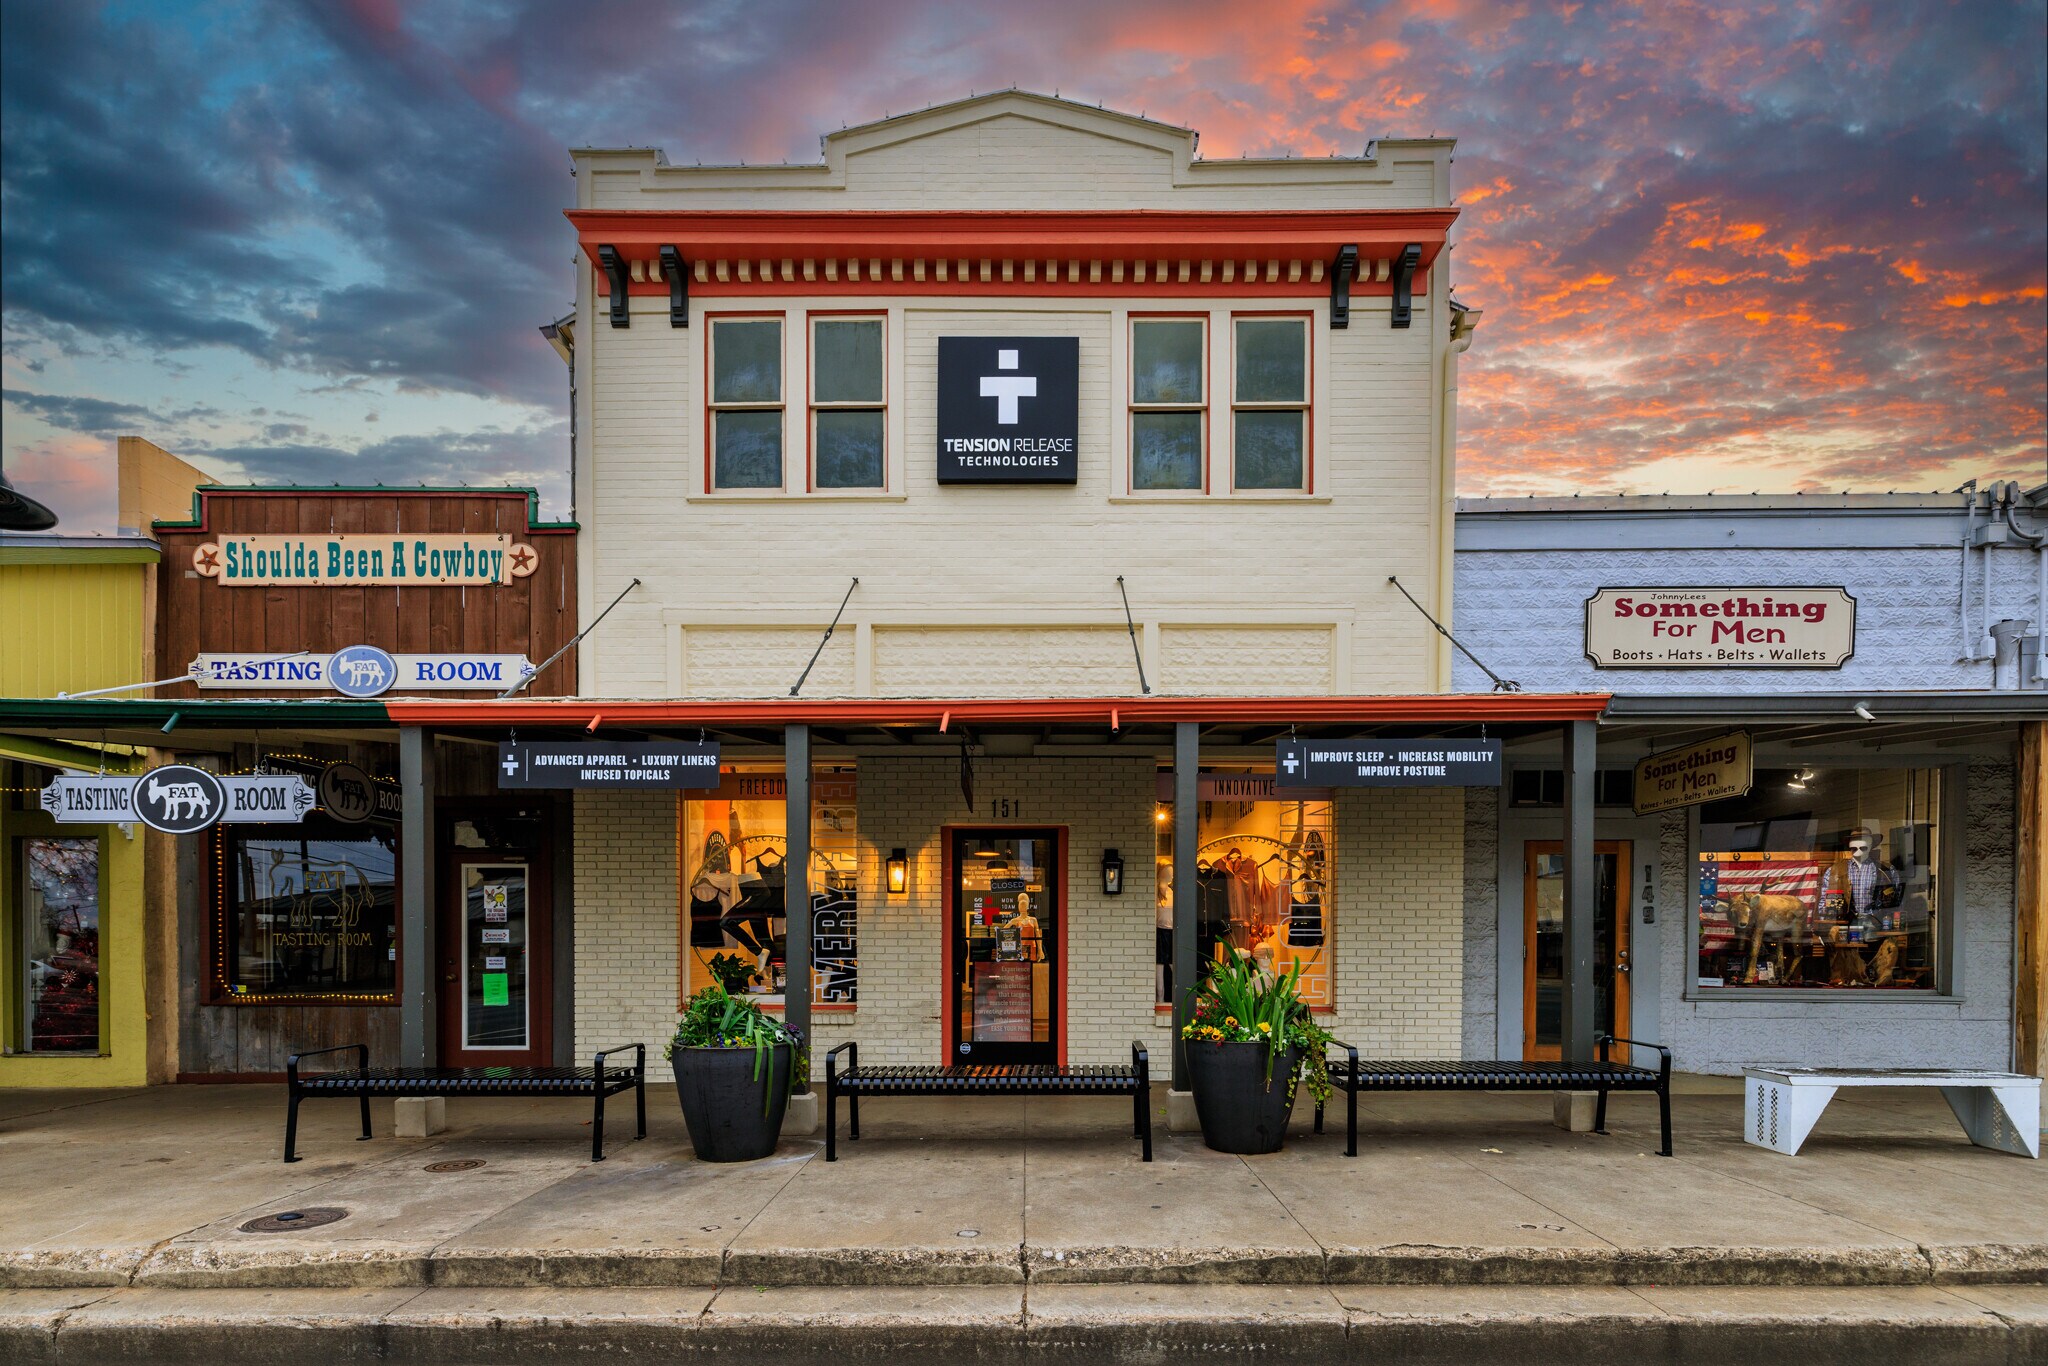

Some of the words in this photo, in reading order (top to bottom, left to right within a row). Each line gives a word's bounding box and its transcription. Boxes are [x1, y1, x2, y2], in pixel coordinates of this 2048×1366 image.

[944, 438, 1010, 452] TENSION
[1013, 438, 1073, 452] RELEASE
[958, 456, 1059, 466] TECHNOLOGIES
[227, 541, 319, 578] Shoulda
[328, 542, 383, 578] Been
[391, 542, 406, 577] A
[414, 541, 503, 583] Cowboy
[1650, 593, 1707, 602] JohnnyLees
[1614, 598, 1827, 623] Something
[1653, 620, 1697, 637] For
[1711, 620, 1786, 645] Men
[1612, 648, 1653, 660] Boots
[1668, 648, 1703, 660] Hats
[1717, 648, 1755, 660] Belts
[1769, 648, 1826, 660] Wallets
[211, 661, 322, 681] TASTING
[416, 662, 502, 681] ROOM
[354, 662, 377, 672] FAT
[535, 755, 584, 766] ADVANCED
[586, 755, 628, 766] APPAREL
[641, 755, 679, 766] LUXURY
[681, 755, 717, 766] LINENS
[1311, 751, 1354, 762] IMPROVE
[1356, 751, 1385, 762] SLEEP
[1398, 751, 1445, 762] INCREASE
[1447, 751, 1493, 762] MOBILITY
[1644, 745, 1737, 781] Something
[581, 769, 621, 780] INFUSED
[624, 769, 670, 780] TOPICALS
[1358, 765, 1401, 776] IMPROVE
[1403, 765, 1446, 776] POSTURE
[343, 781, 362, 794] FAT
[739, 778, 787, 795] FREEDO
[1214, 779, 1275, 796] INNOVATIVE
[1658, 778, 1677, 792] For
[1682, 770, 1717, 792] Men
[65, 787, 129, 811] TASTING
[234, 787, 287, 811] ROOM
[168, 786, 199, 799] FAT
[379, 789, 402, 813] ROO
[1641, 801, 1659, 810] Knives
[1663, 797, 1679, 806] Hats
[1684, 792, 1701, 801] Belts
[1707, 785, 1736, 796] Wallets
[992, 799, 1018, 818] 151
[305, 871, 345, 889] FAT
[991, 881, 1025, 890] CLOSED
[974, 897, 983, 925] HOURS
[1278, 800, 1332, 1005] CLOTHIN
[273, 933, 331, 946] TASTING
[338, 933, 373, 946] ROOM
[814, 882, 857, 1003] EVERY
